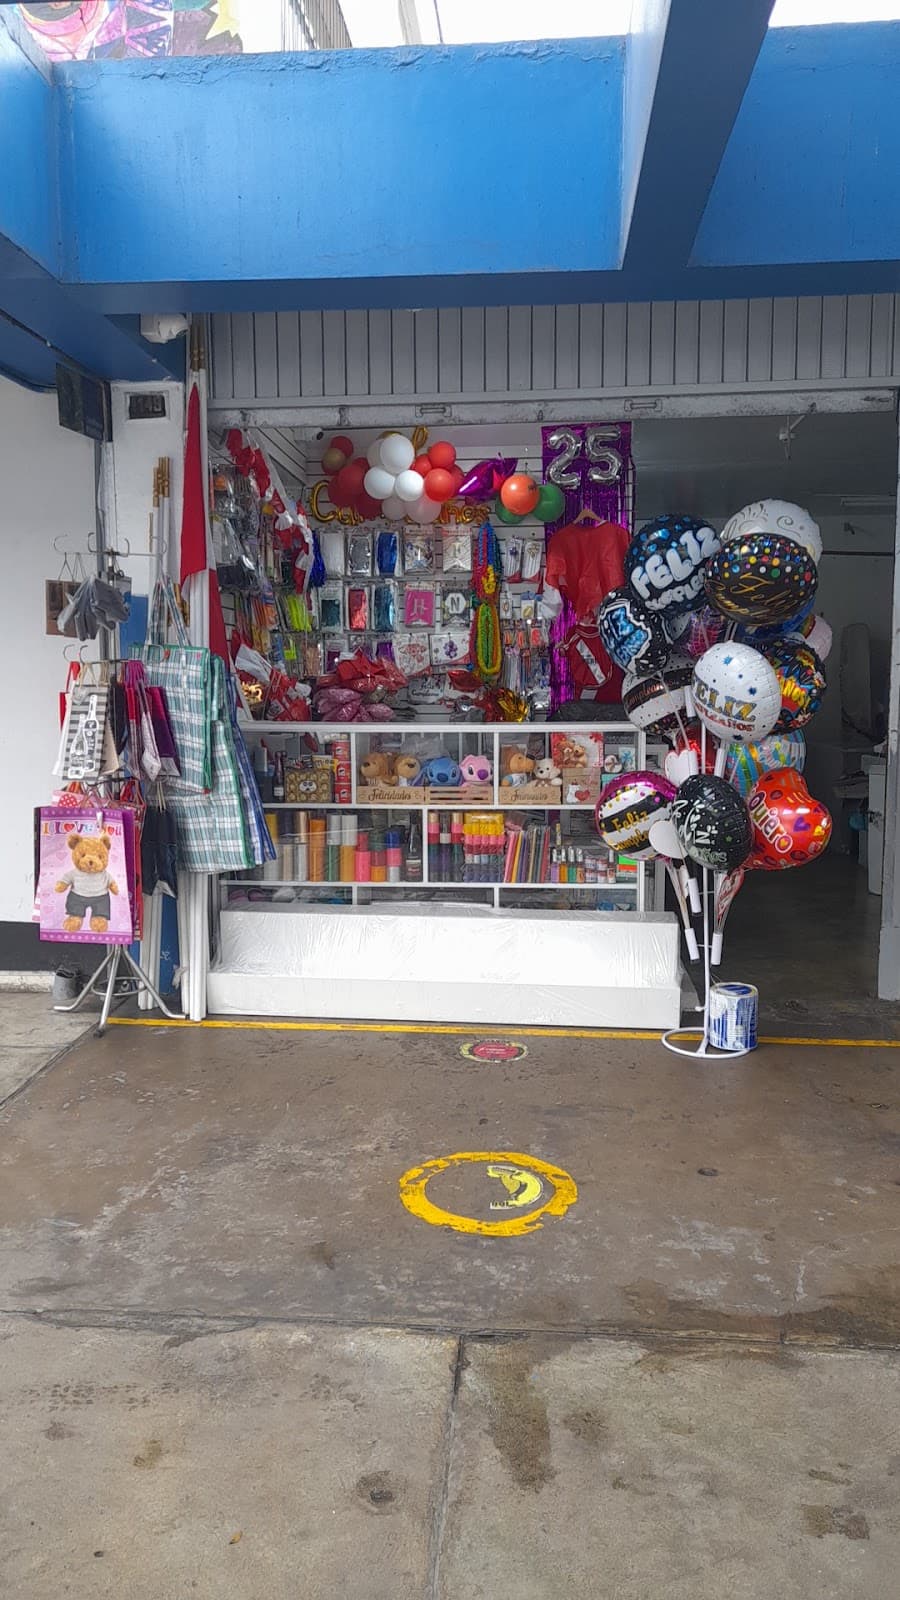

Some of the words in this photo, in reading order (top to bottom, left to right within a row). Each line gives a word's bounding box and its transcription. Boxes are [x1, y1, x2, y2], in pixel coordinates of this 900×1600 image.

[546, 425, 623, 490] 25
[630, 526, 721, 600] FELIZ
[611, 810, 650, 832] Feliz
